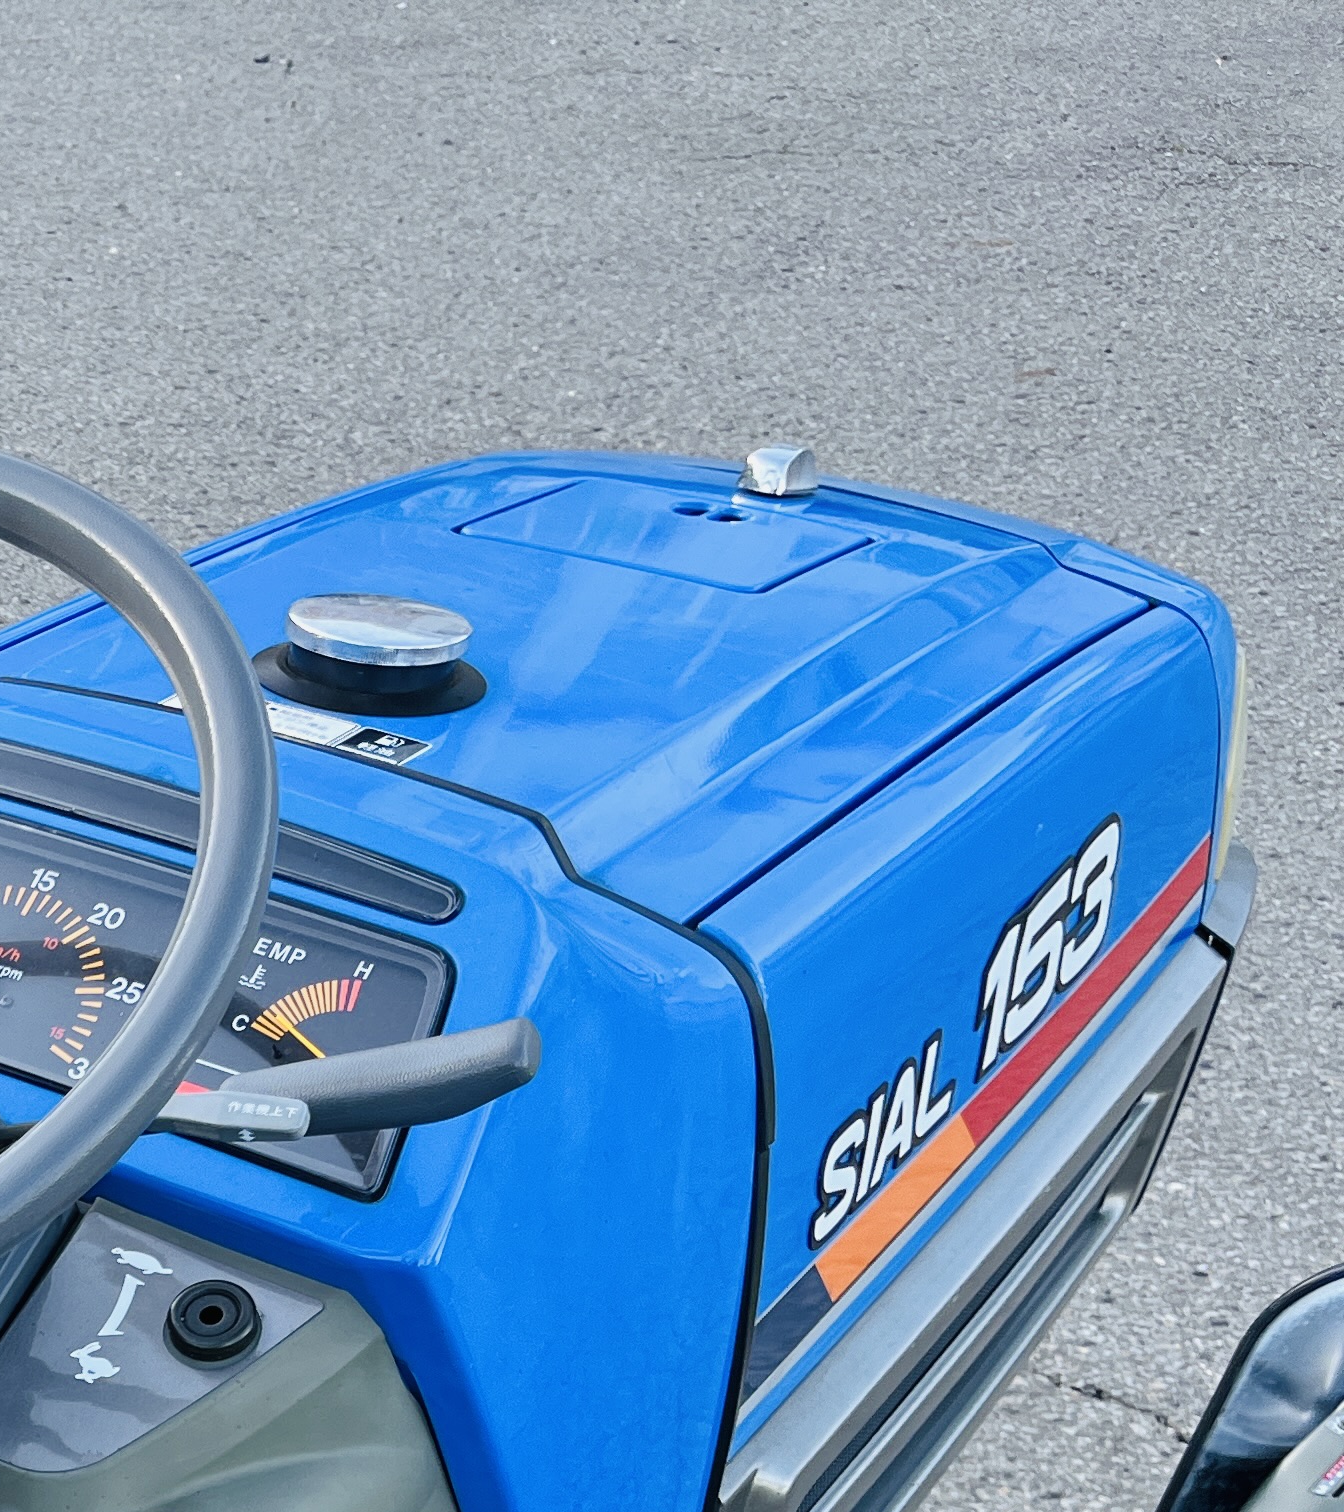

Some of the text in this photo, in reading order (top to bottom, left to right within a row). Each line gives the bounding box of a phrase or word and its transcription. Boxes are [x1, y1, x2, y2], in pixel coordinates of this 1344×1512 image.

[30, 868, 60, 892] 15
[87, 902, 126, 930] 20
[43, 936, 59, 951] 10
[252, 937, 308, 968] EMP
[973, 813, 1120, 1083] 153
[353, 960, 374, 980] H
[105, 976, 146, 1005] 25
[49, 1026, 66, 1040] 15
[231, 1013, 250, 1032] C
[67, 1057, 90, 1080] 3
[810, 1031, 955, 1248] SIAL
